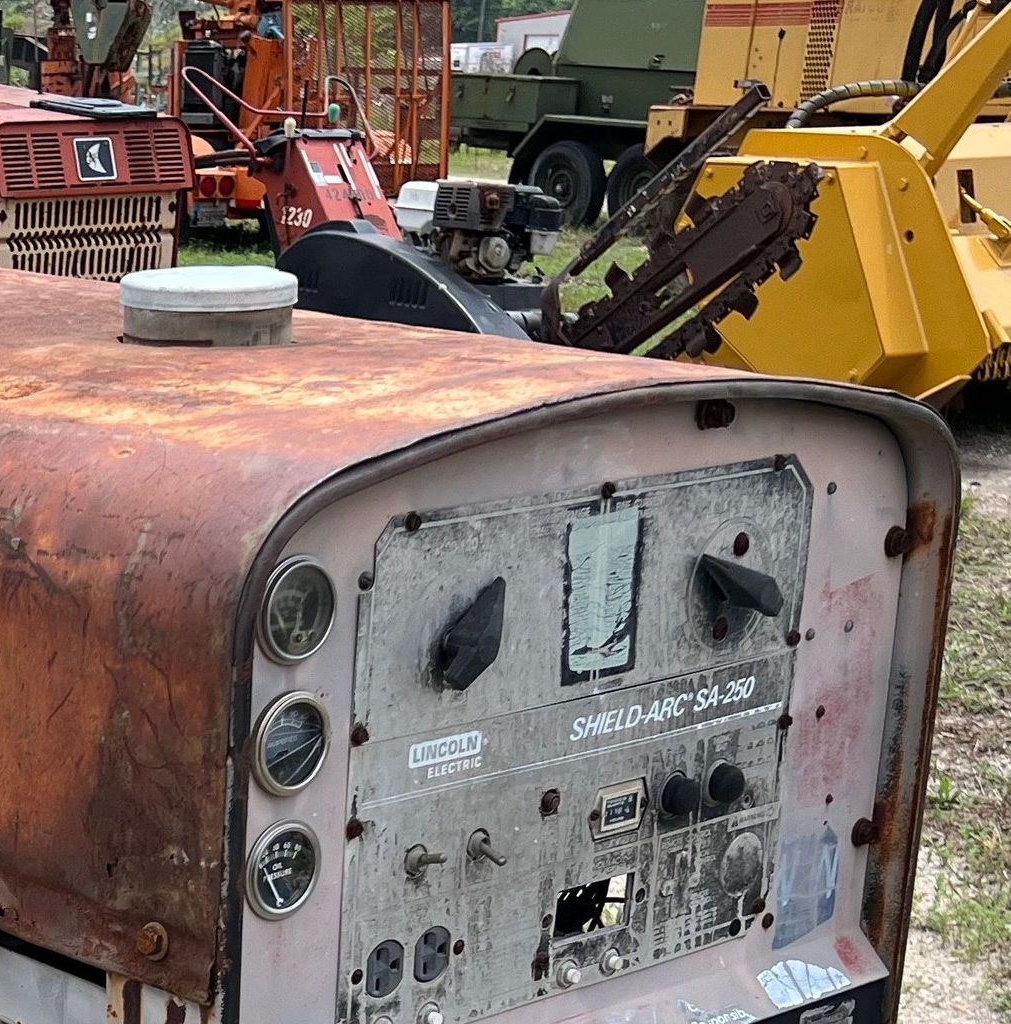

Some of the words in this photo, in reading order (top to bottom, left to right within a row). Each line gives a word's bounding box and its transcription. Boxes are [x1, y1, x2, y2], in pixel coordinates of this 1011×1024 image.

[693, 676, 756, 712] SA-250
[412, 735, 478, 763] LINCOLN
[427, 756, 483, 779] ELECTRIC
